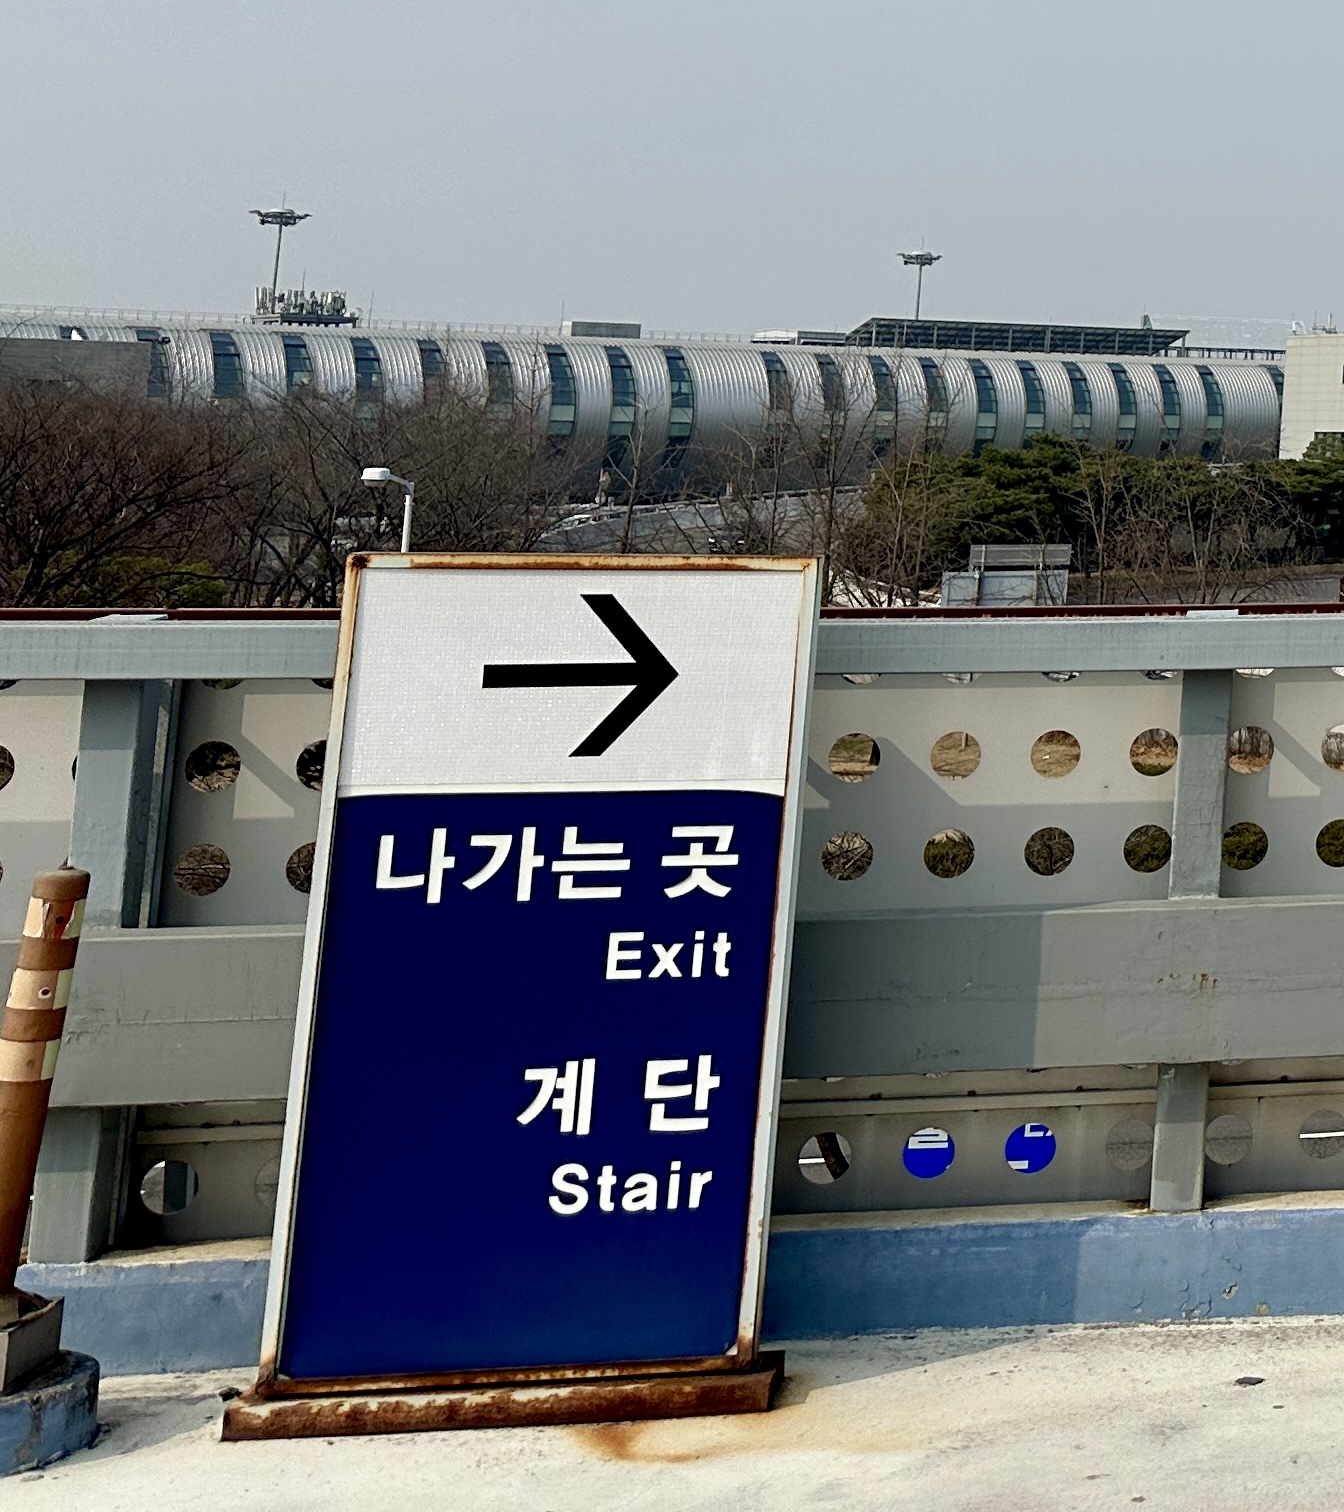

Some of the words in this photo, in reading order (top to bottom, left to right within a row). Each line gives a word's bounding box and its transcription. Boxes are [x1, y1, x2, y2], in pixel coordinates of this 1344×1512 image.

[375, 826, 631, 904] 나가는
[661, 825, 739, 899] 곳
[605, 930, 732, 980] Exit
[516, 1058, 596, 1136] 계
[643, 1054, 721, 1132] 단
[548, 1160, 713, 1215] Stair
